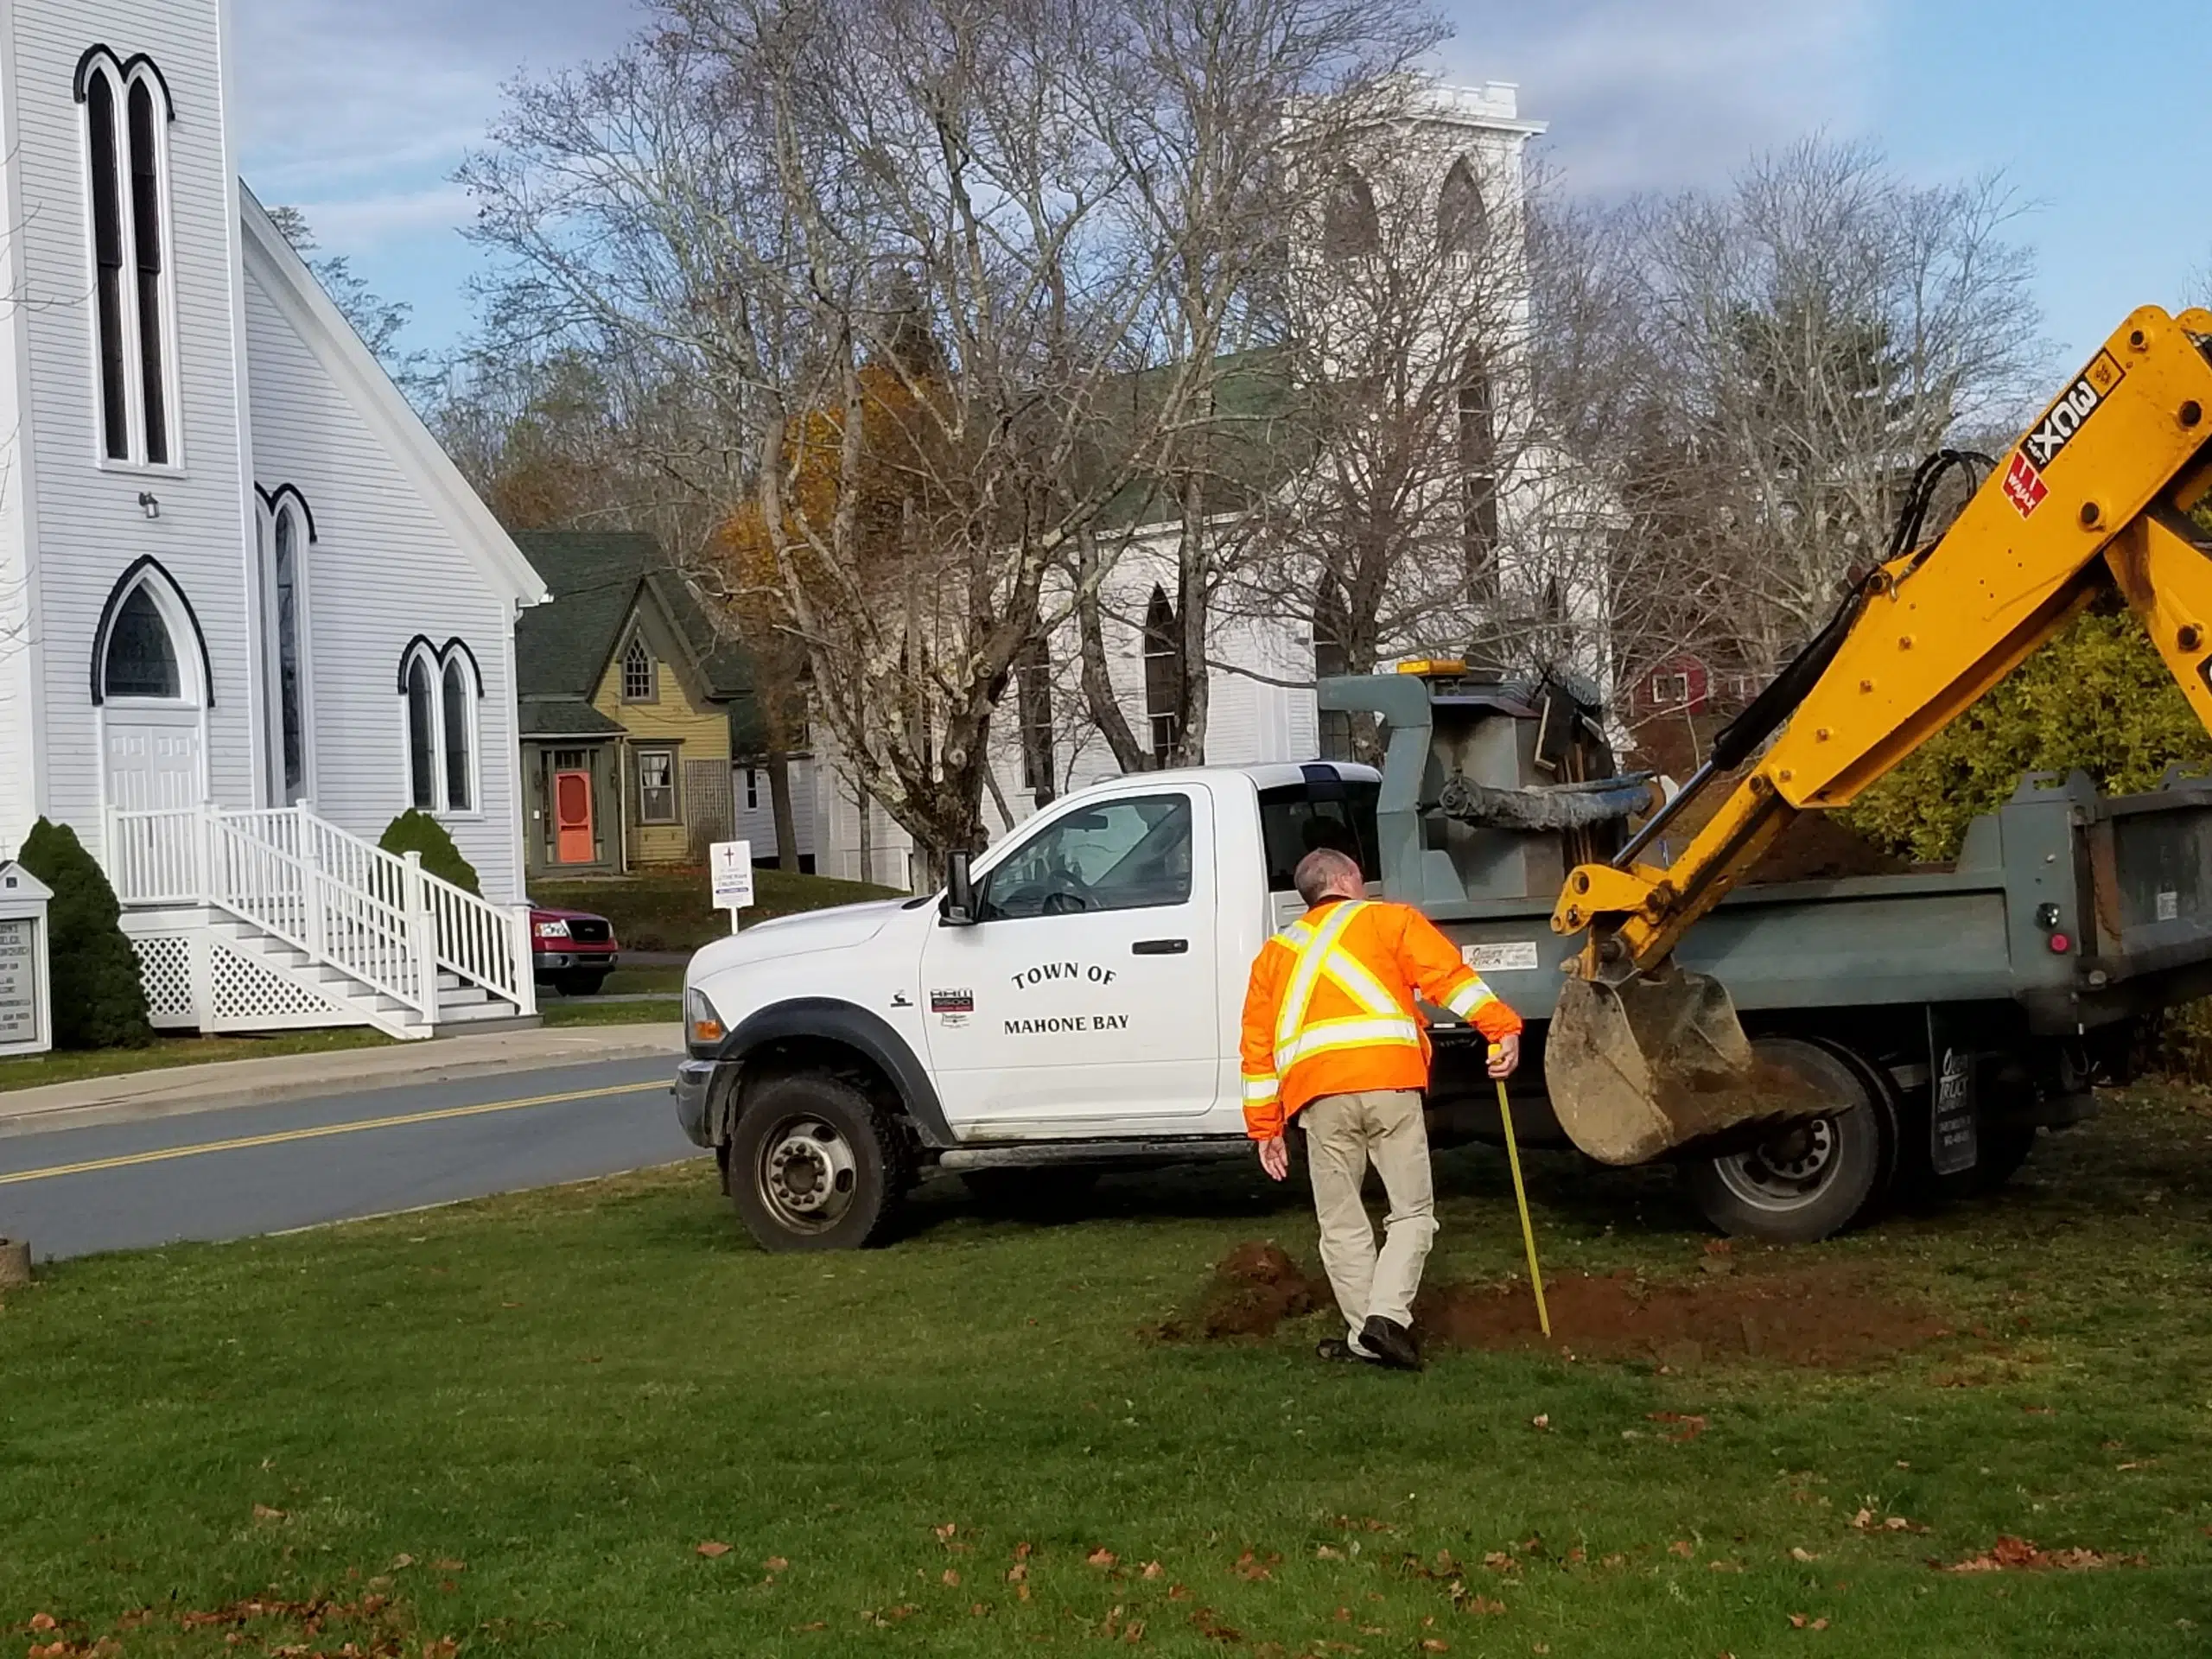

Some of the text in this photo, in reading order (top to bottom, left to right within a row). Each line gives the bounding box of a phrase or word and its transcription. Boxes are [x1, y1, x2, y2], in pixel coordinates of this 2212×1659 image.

[2031, 380, 2098, 461] 3CX
[2007, 473, 2037, 510] WAJAX
[1011, 962, 1117, 989] TOWN OF
[1003, 1014, 1129, 1035] MAHONE BAY
